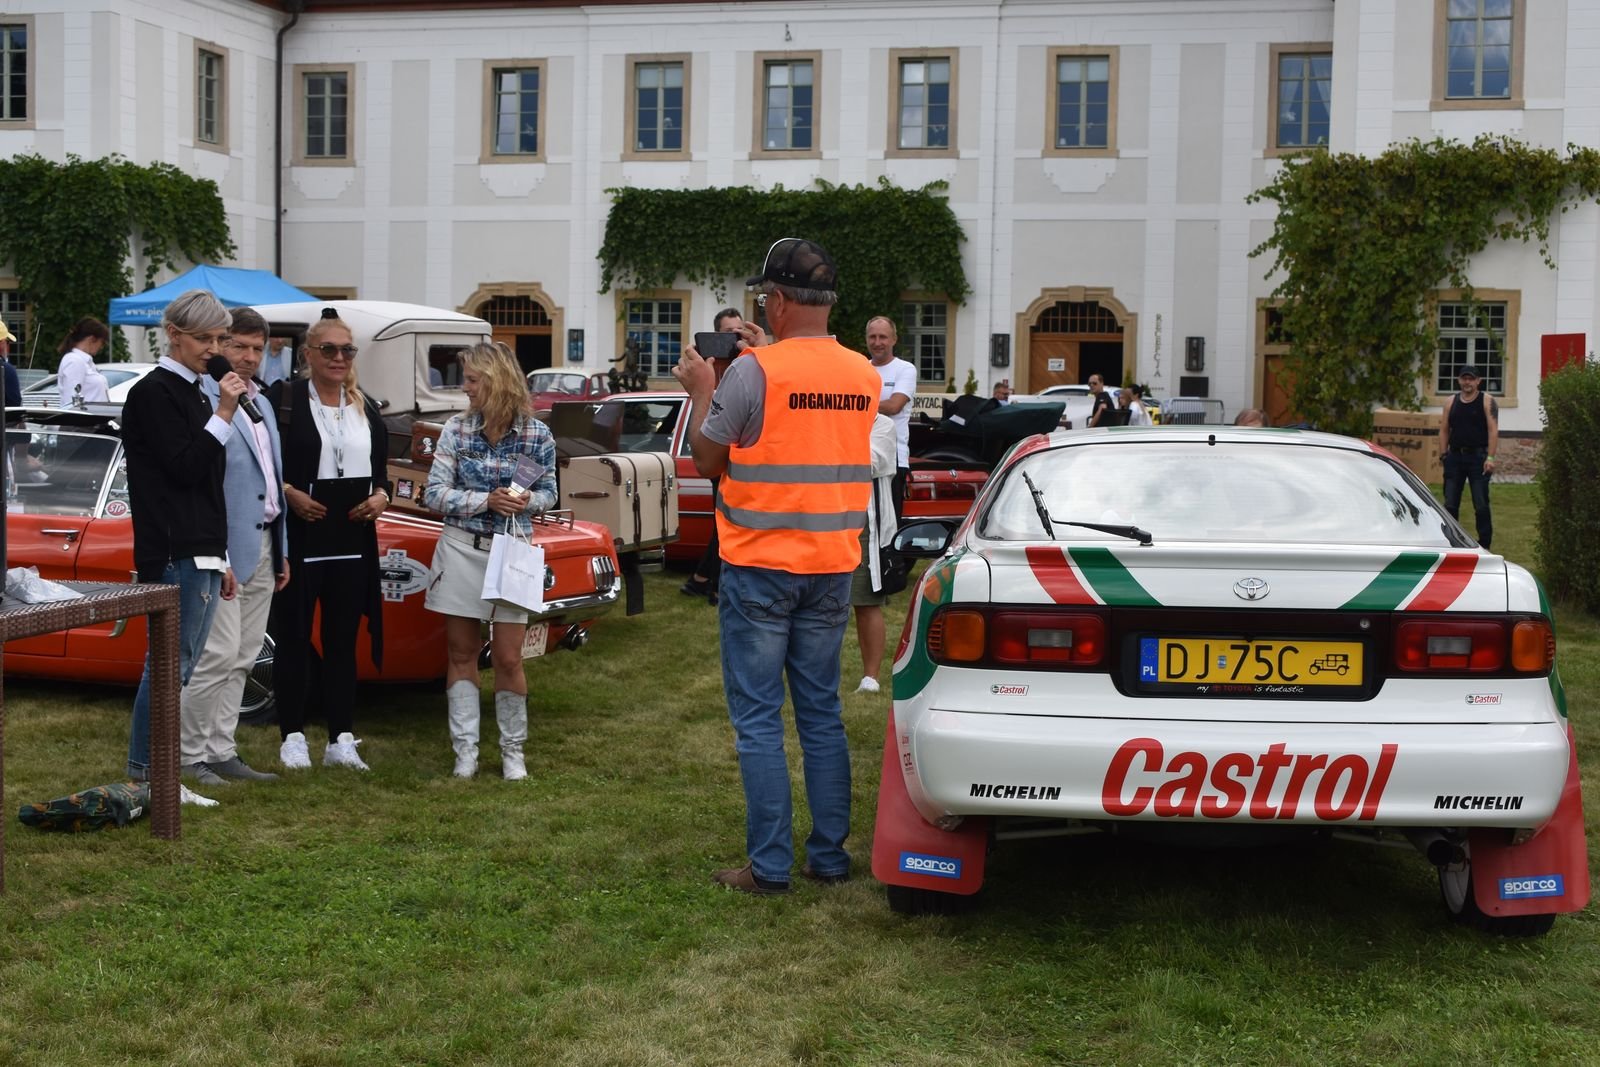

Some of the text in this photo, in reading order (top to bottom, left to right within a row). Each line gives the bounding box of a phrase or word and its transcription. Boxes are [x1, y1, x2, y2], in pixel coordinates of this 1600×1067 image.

[125, 306, 163, 319] www.pie
[109, 502, 126, 514] STP
[1166, 643, 1300, 682] DJ 75C
[1142, 666, 1156, 676] PL
[1000, 685, 1026, 695] Castrol
[1197, 685, 1209, 693] my
[1265, 685, 1304, 693] fantastic
[1475, 695, 1499, 704] Castrol
[1101, 737, 1399, 821] Castrol
[970, 783, 1062, 801] MICHELIN
[1433, 795, 1524, 810] MICHELIN
[905, 857, 956, 873] sparco
[1503, 879, 1557, 895] sparco
